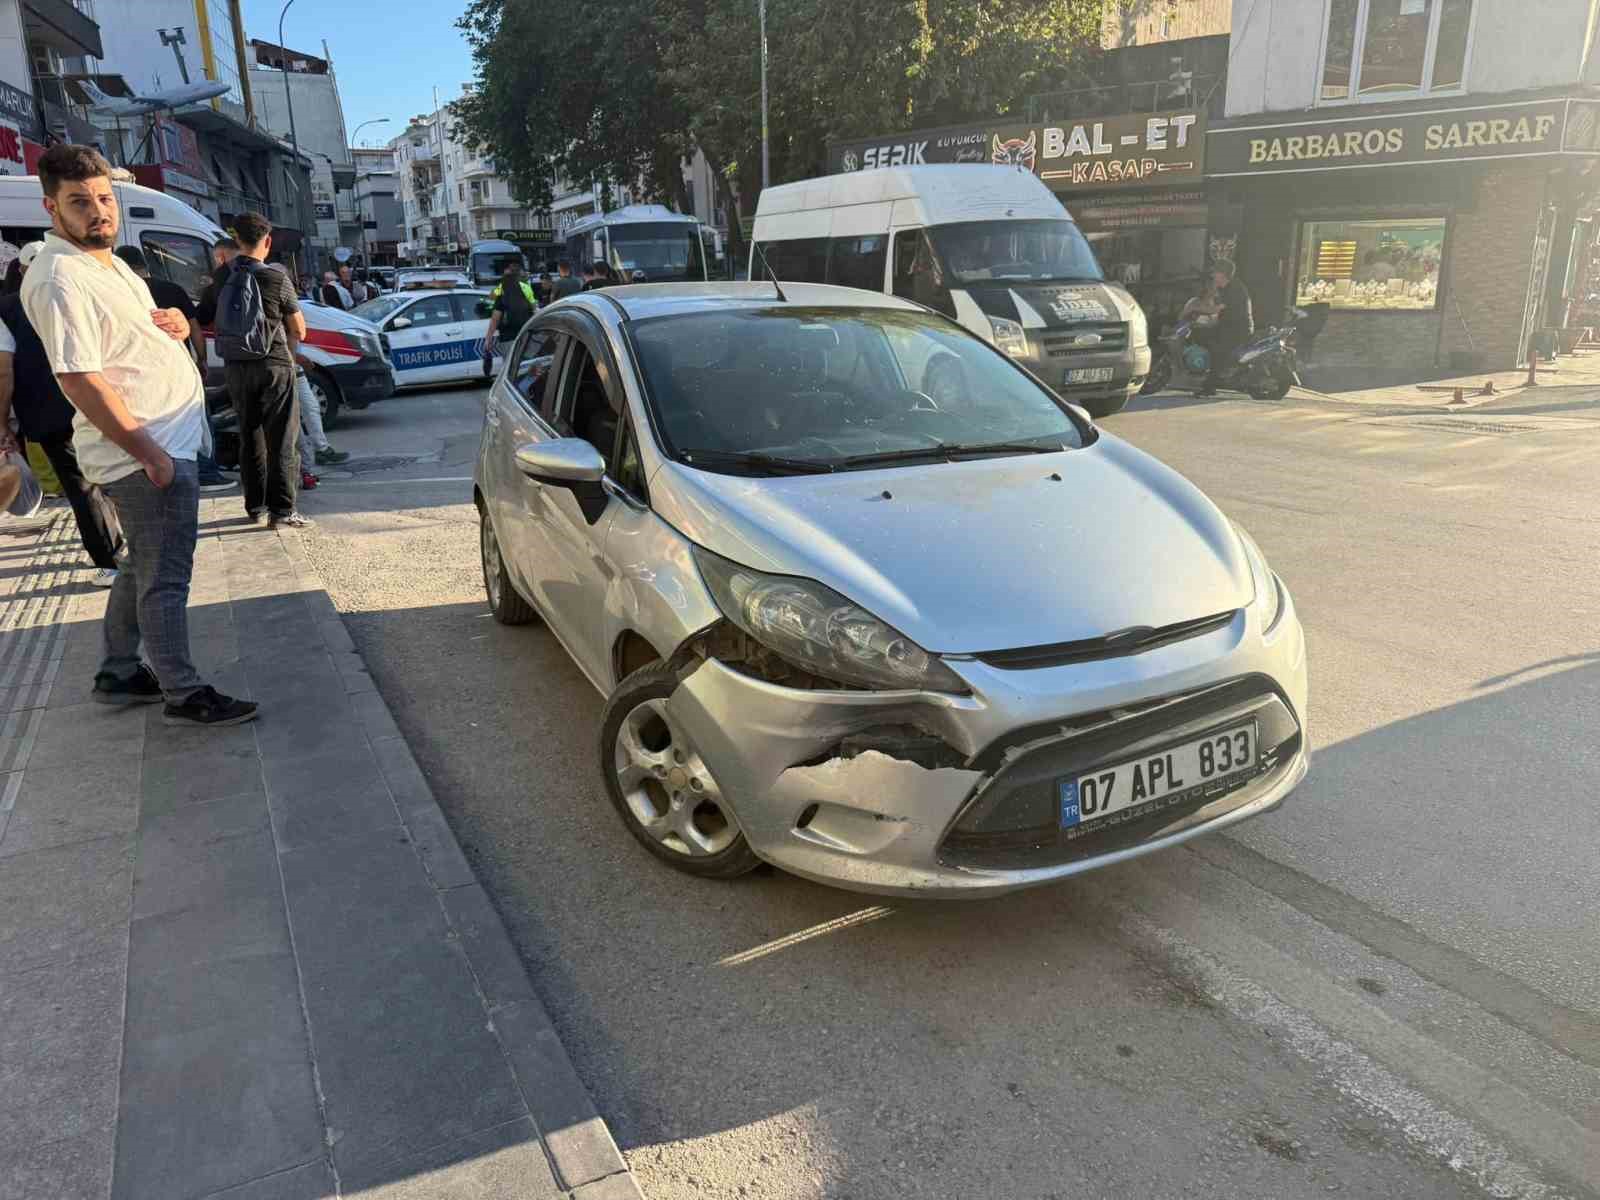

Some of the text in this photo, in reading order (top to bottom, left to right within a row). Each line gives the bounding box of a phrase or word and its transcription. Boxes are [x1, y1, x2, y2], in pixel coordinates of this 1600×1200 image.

[1042, 122, 1113, 159] BAL
[1146, 114, 1196, 150] ET
[1249, 113, 1555, 164] BARBAROS SARRAF
[1072, 158, 1157, 184] KASAP
[1079, 771, 1116, 816] 07
[1131, 753, 1184, 802] APL
[1199, 729, 1250, 778] 833
[1064, 804, 1079, 818] TR
